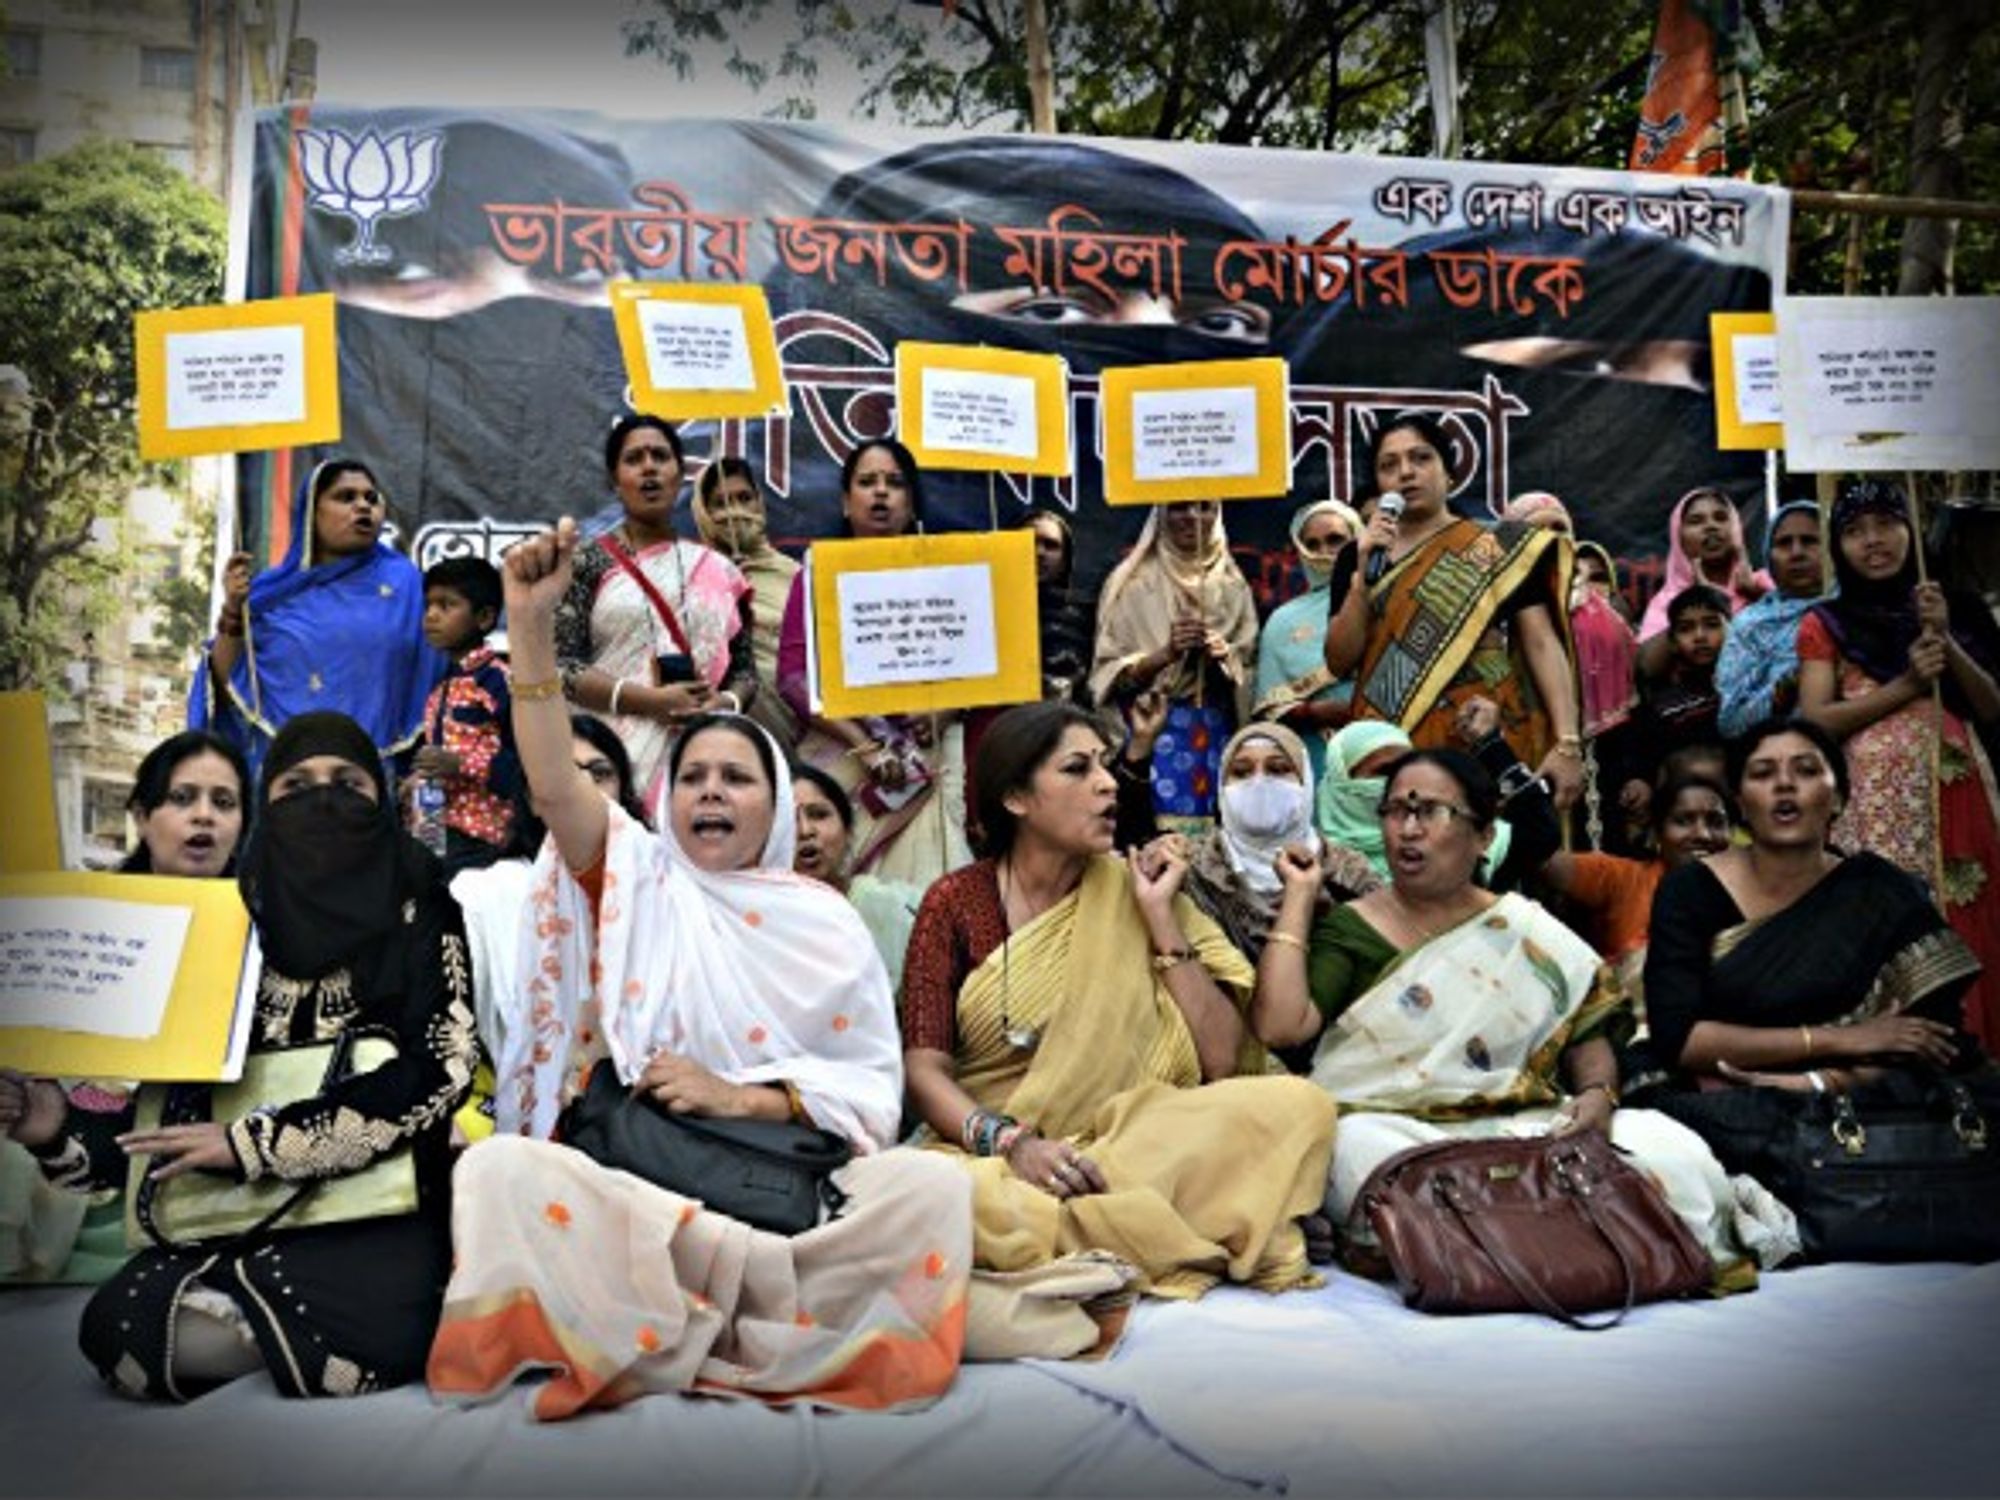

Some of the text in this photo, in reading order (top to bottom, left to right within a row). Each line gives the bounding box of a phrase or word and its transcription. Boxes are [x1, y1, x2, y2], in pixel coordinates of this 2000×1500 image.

[483, 182, 1587, 318] ভারতীয় জনতা মহিলা মোর্চার ডাকে
[1375, 178, 1745, 247] এক দেশ এক আইন
